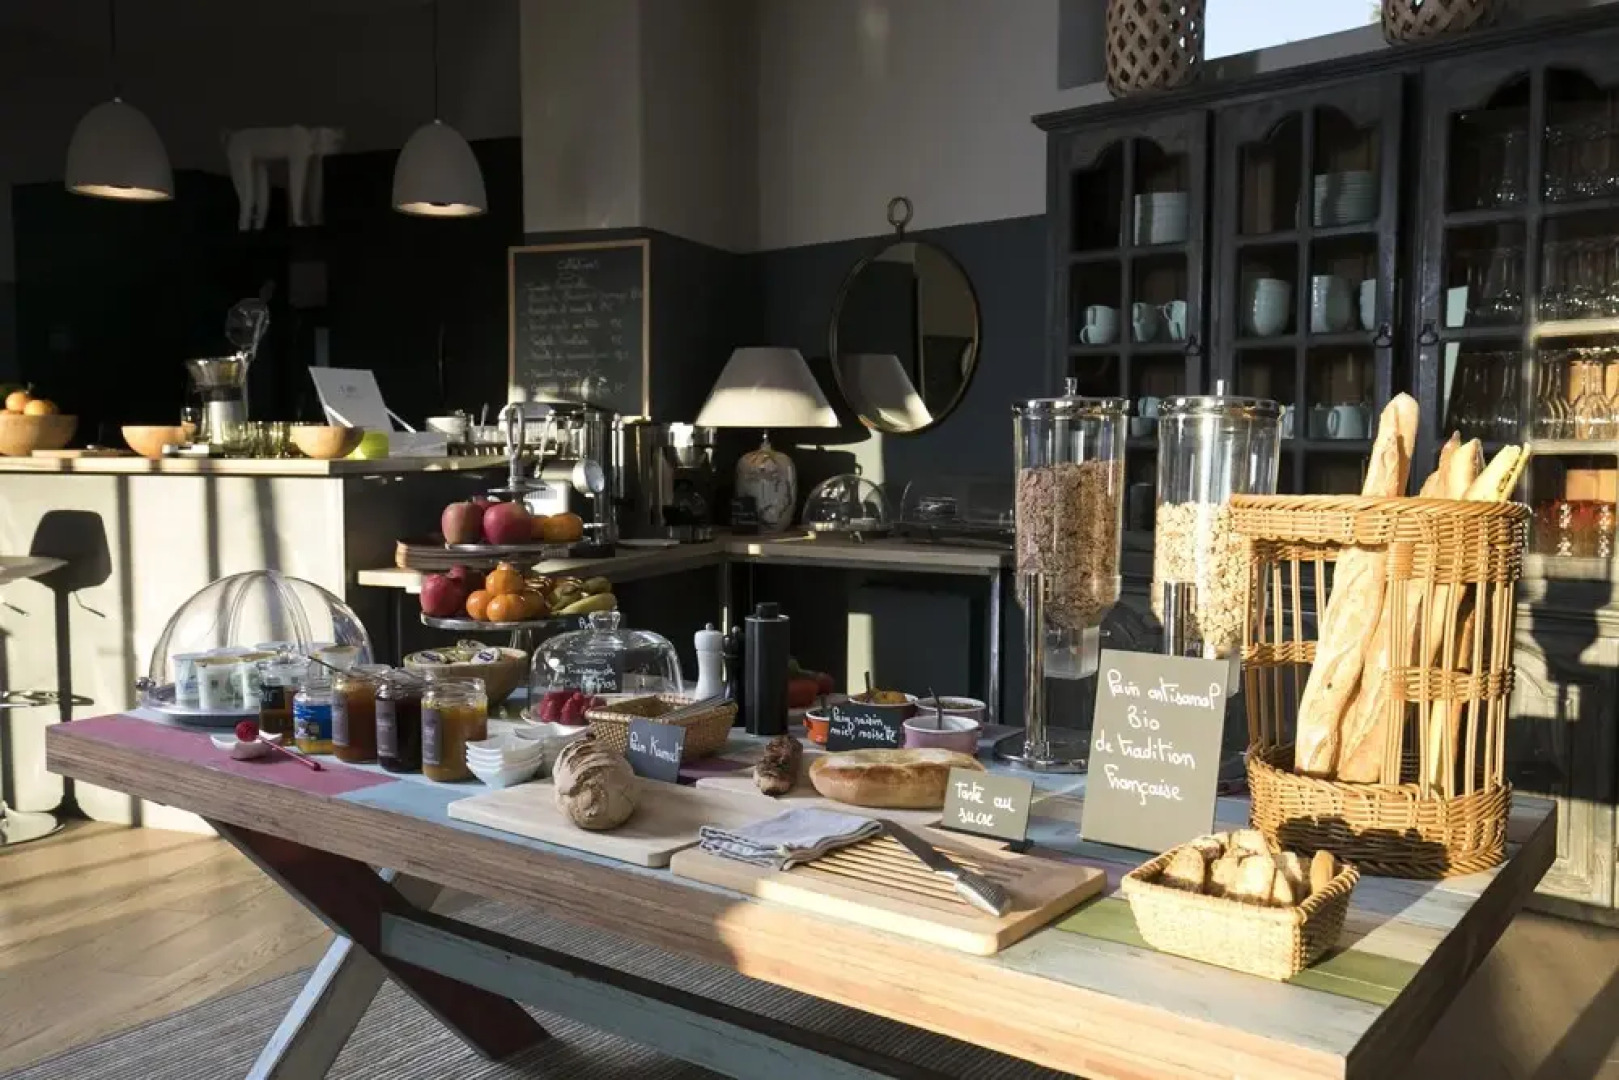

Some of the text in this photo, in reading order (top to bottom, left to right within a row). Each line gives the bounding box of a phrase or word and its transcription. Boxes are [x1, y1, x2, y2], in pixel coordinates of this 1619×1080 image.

[1107, 669, 1222, 710] Pain artisanal
[832, 706, 850, 723] Pain
[1127, 705, 1160, 731] Bio
[629, 731, 647, 753] Pain
[1095, 728, 1196, 770] de tradition
[1103, 764, 1184, 806] Française
[993, 796, 1016, 812] au
[958, 807, 995, 827] sucre
